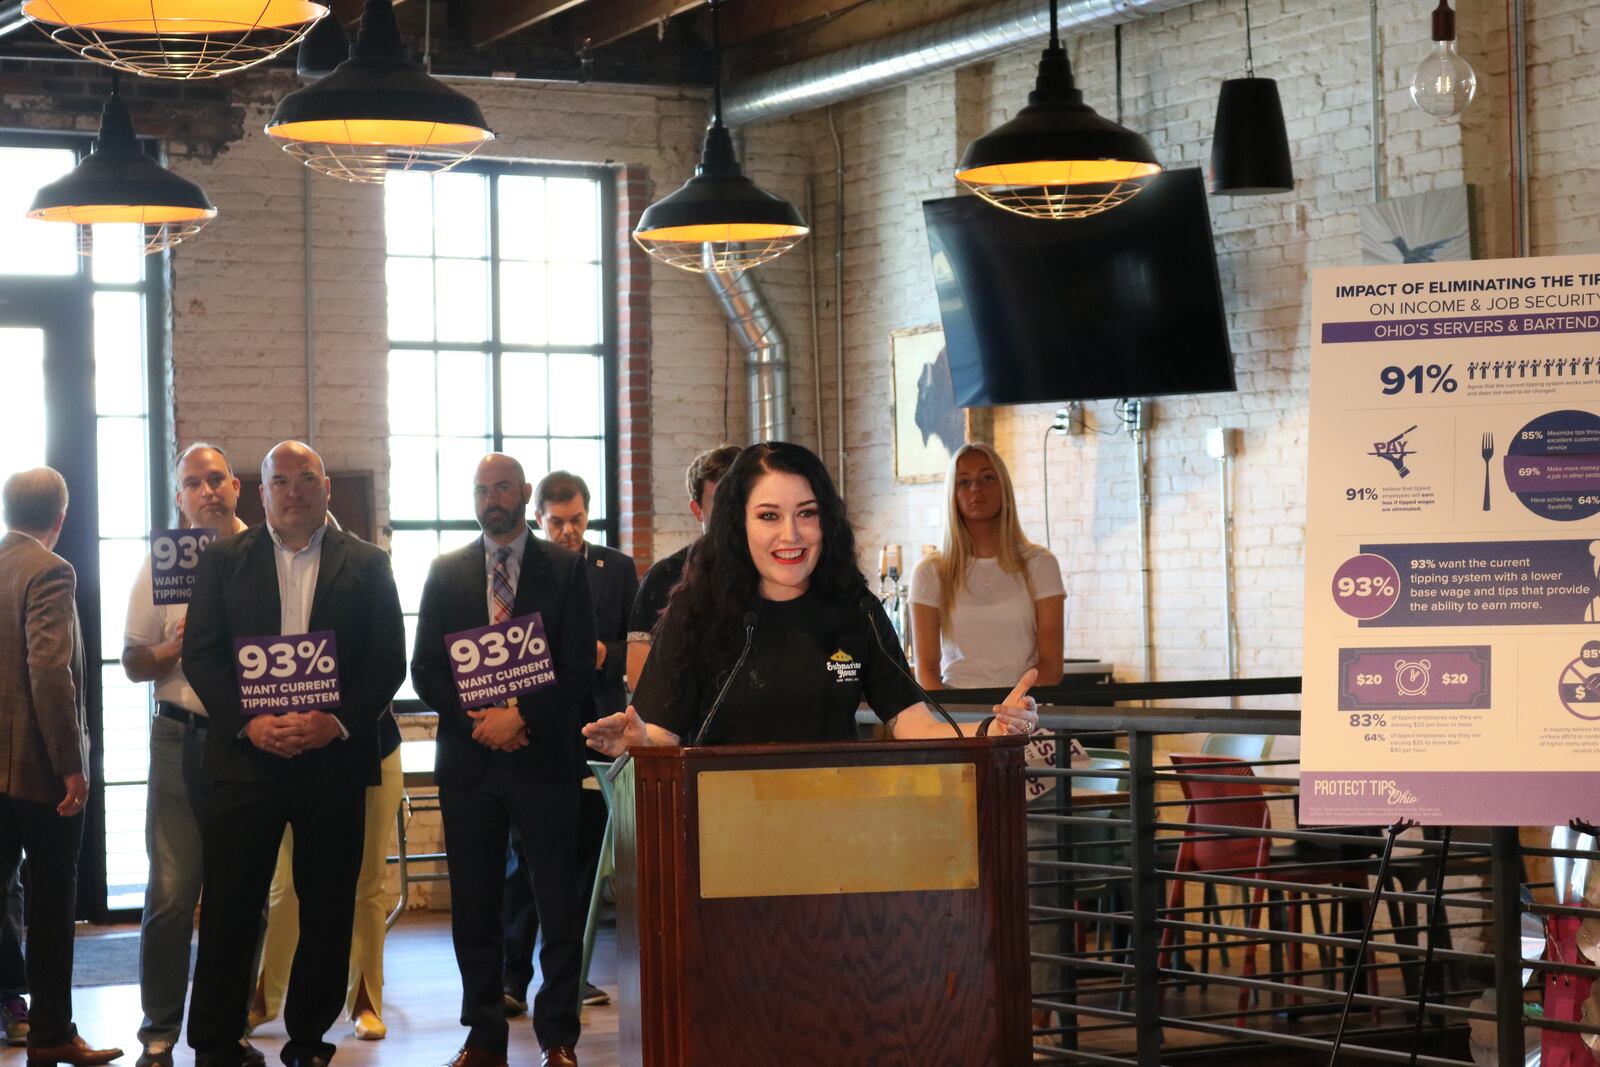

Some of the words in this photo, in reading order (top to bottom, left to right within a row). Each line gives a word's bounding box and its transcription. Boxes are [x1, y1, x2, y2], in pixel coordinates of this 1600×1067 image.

[1336, 284, 1397, 298] IMPACT
[1402, 282, 1424, 295] OF
[1429, 277, 1536, 293] ELIMINATING
[1541, 275, 1574, 288] THE
[1370, 303, 1395, 316] ON
[1400, 299, 1465, 314] INCOME
[1470, 299, 1481, 312] &
[1487, 297, 1519, 310] JOB
[1375, 323, 1429, 338] OHIO'S
[1433, 320, 1504, 335] SERVERS
[1508, 319, 1518, 332] &
[1524, 316, 1600, 331] BARTEND
[1380, 364, 1458, 395] 91%
[1521, 431, 1543, 440] 85%
[1373, 440, 1408, 453] PAY
[1518, 467, 1540, 476] 69%
[1346, 488, 1378, 500] 91%
[1578, 496, 1600, 505] 64%
[1411, 559, 1436, 569] 93%
[1439, 560, 1466, 568] want
[1469, 558, 1487, 568] the
[1490, 558, 1531, 568] current
[154, 575, 184, 586] WANT
[1410, 573, 1449, 584] tipping
[1451, 573, 1491, 584] system
[1494, 571, 1518, 581] with
[1521, 573, 1528, 581] a
[1531, 571, 1563, 580] lower
[154, 587, 192, 599] TIPPING
[1338, 576, 1394, 597] 93%
[1410, 587, 1437, 597] base
[1440, 588, 1471, 598] wage
[1474, 586, 1495, 596] and
[1498, 586, 1518, 597] tips
[1522, 585, 1544, 595] that
[1547, 584, 1590, 596] provide
[1410, 602, 1428, 611] the
[1431, 601, 1464, 612] ability
[1467, 602, 1479, 610] to
[1481, 602, 1507, 610] earn
[1510, 601, 1543, 610] more.
[450, 621, 545, 673] 93%
[1582, 649, 1600, 658] 85
[238, 639, 335, 679] 93%
[458, 674, 493, 690] WANT
[495, 658, 550, 681] CURRENT
[1356, 672, 1382, 686] $20
[1442, 672, 1468, 686] $20
[241, 684, 277, 696] WANT
[280, 678, 337, 693] CURRENT
[459, 685, 507, 703] TIPPING
[508, 670, 555, 691] SYSTEM
[1575, 685, 1586, 701] $
[241, 697, 288, 709] TIPPING
[291, 692, 340, 705] SYSTEM
[1349, 713, 1387, 728] 83%
[1364, 734, 1386, 742] 64%
[1314, 780, 1367, 796] PROTECT
[1370, 780, 1396, 796] TIPS
[1387, 790, 1419, 805] Ohio
